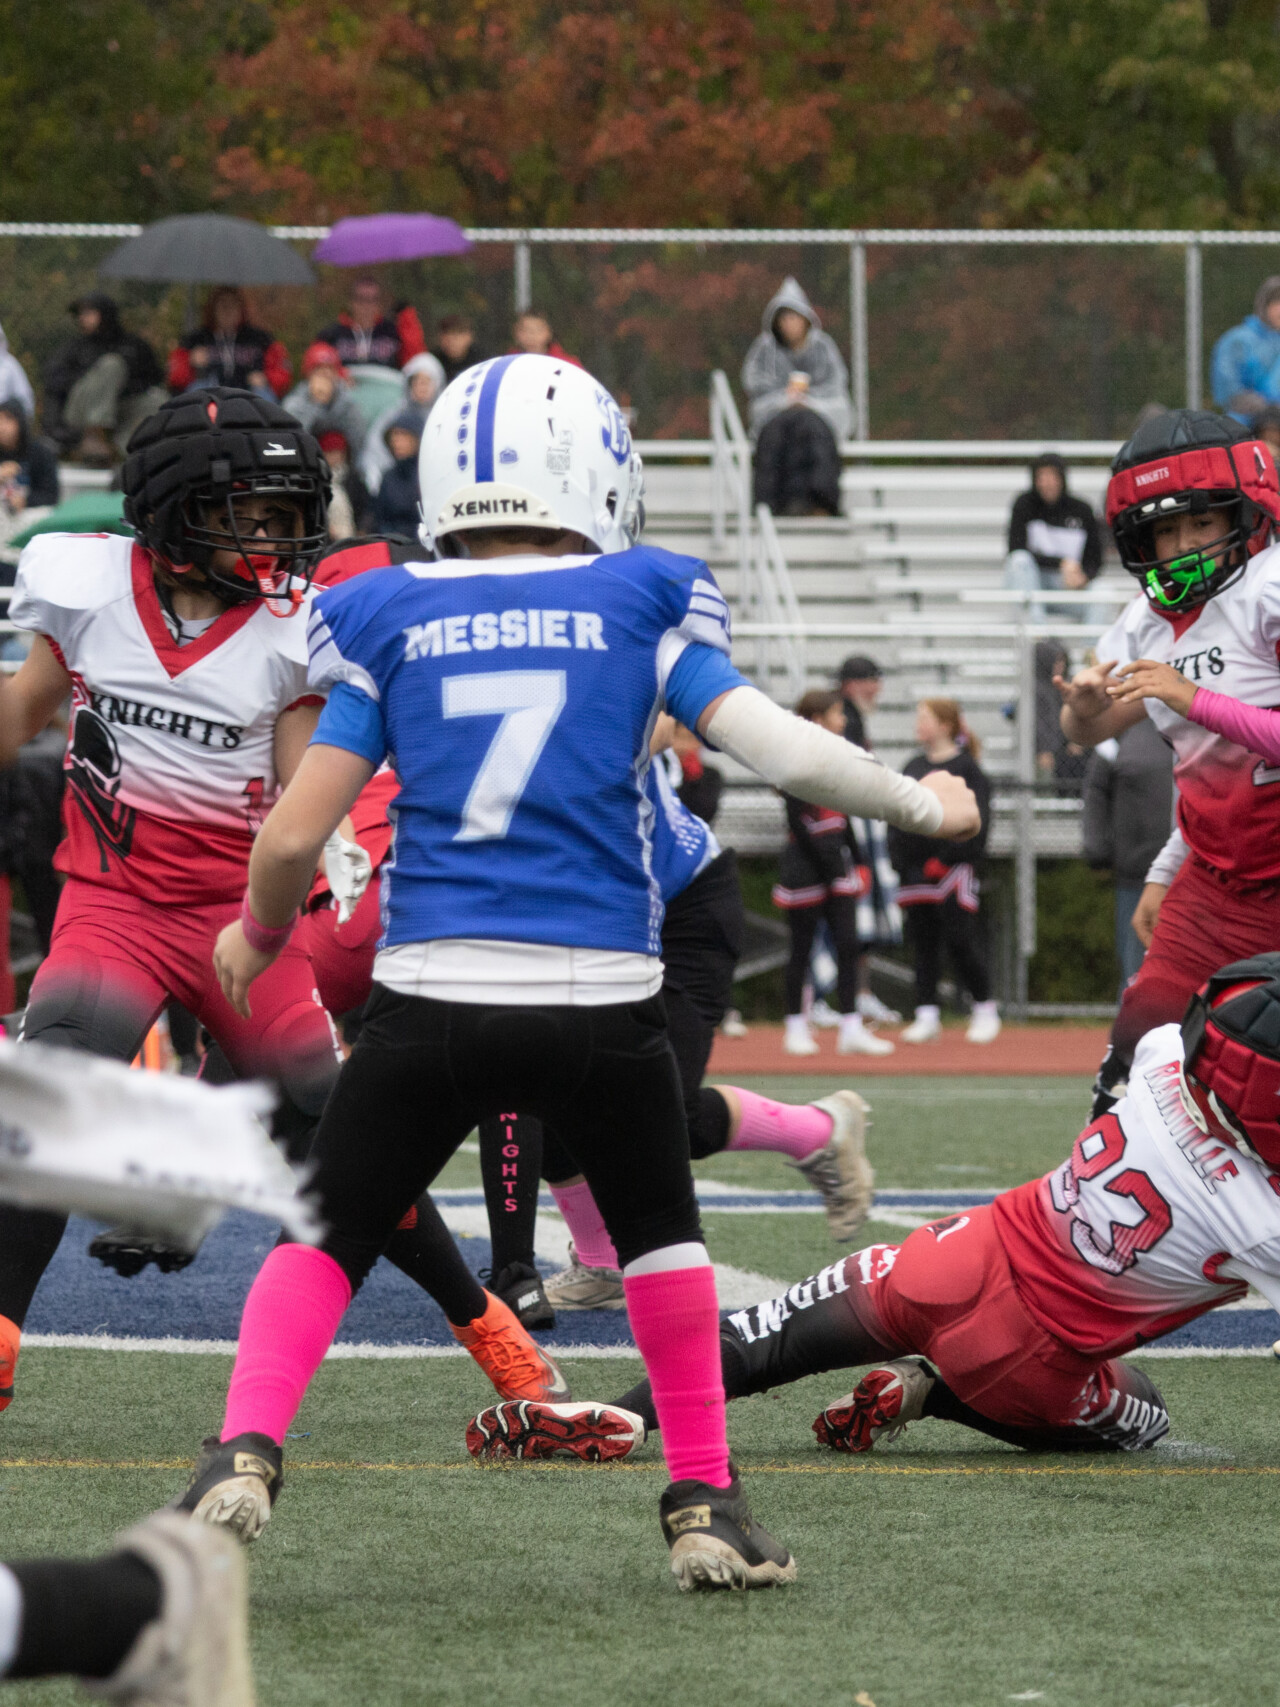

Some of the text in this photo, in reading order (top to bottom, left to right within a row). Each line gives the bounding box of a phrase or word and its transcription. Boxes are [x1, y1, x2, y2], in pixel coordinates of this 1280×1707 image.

[452, 498, 528, 517] XENITH
[403, 611, 608, 662] MESSIER
[91, 692, 244, 749] KNIGHTS
[441, 669, 567, 842] 7
[499, 1112, 520, 1213] NIGHTS
[1049, 1112, 1174, 1277] 83
[518, 1290, 540, 1311] NIKE
